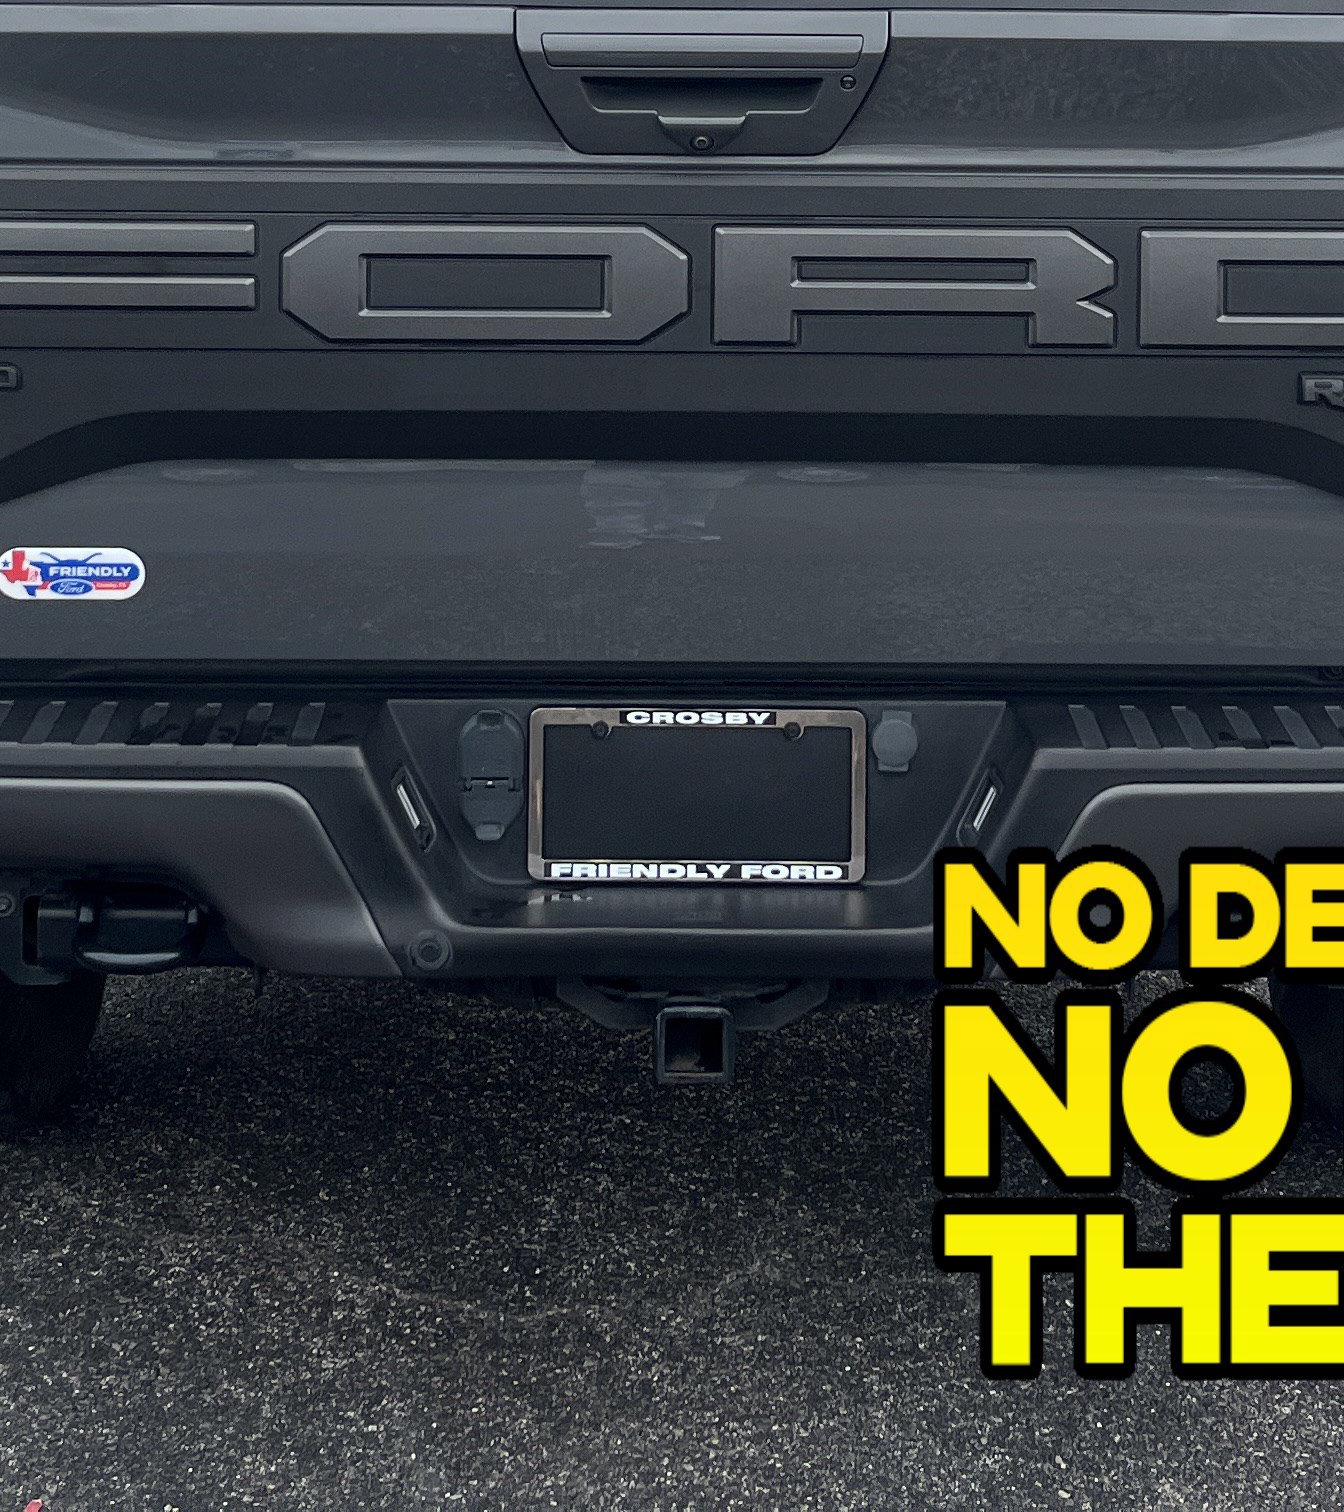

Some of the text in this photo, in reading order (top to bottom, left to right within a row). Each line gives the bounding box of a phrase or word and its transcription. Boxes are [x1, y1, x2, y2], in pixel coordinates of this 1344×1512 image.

[49, 566, 131, 577] FRIENDLY
[57, 580, 85, 594] Ford
[626, 711, 771, 725] CROSBY
[550, 863, 844, 880] FRIENDLY FORD
